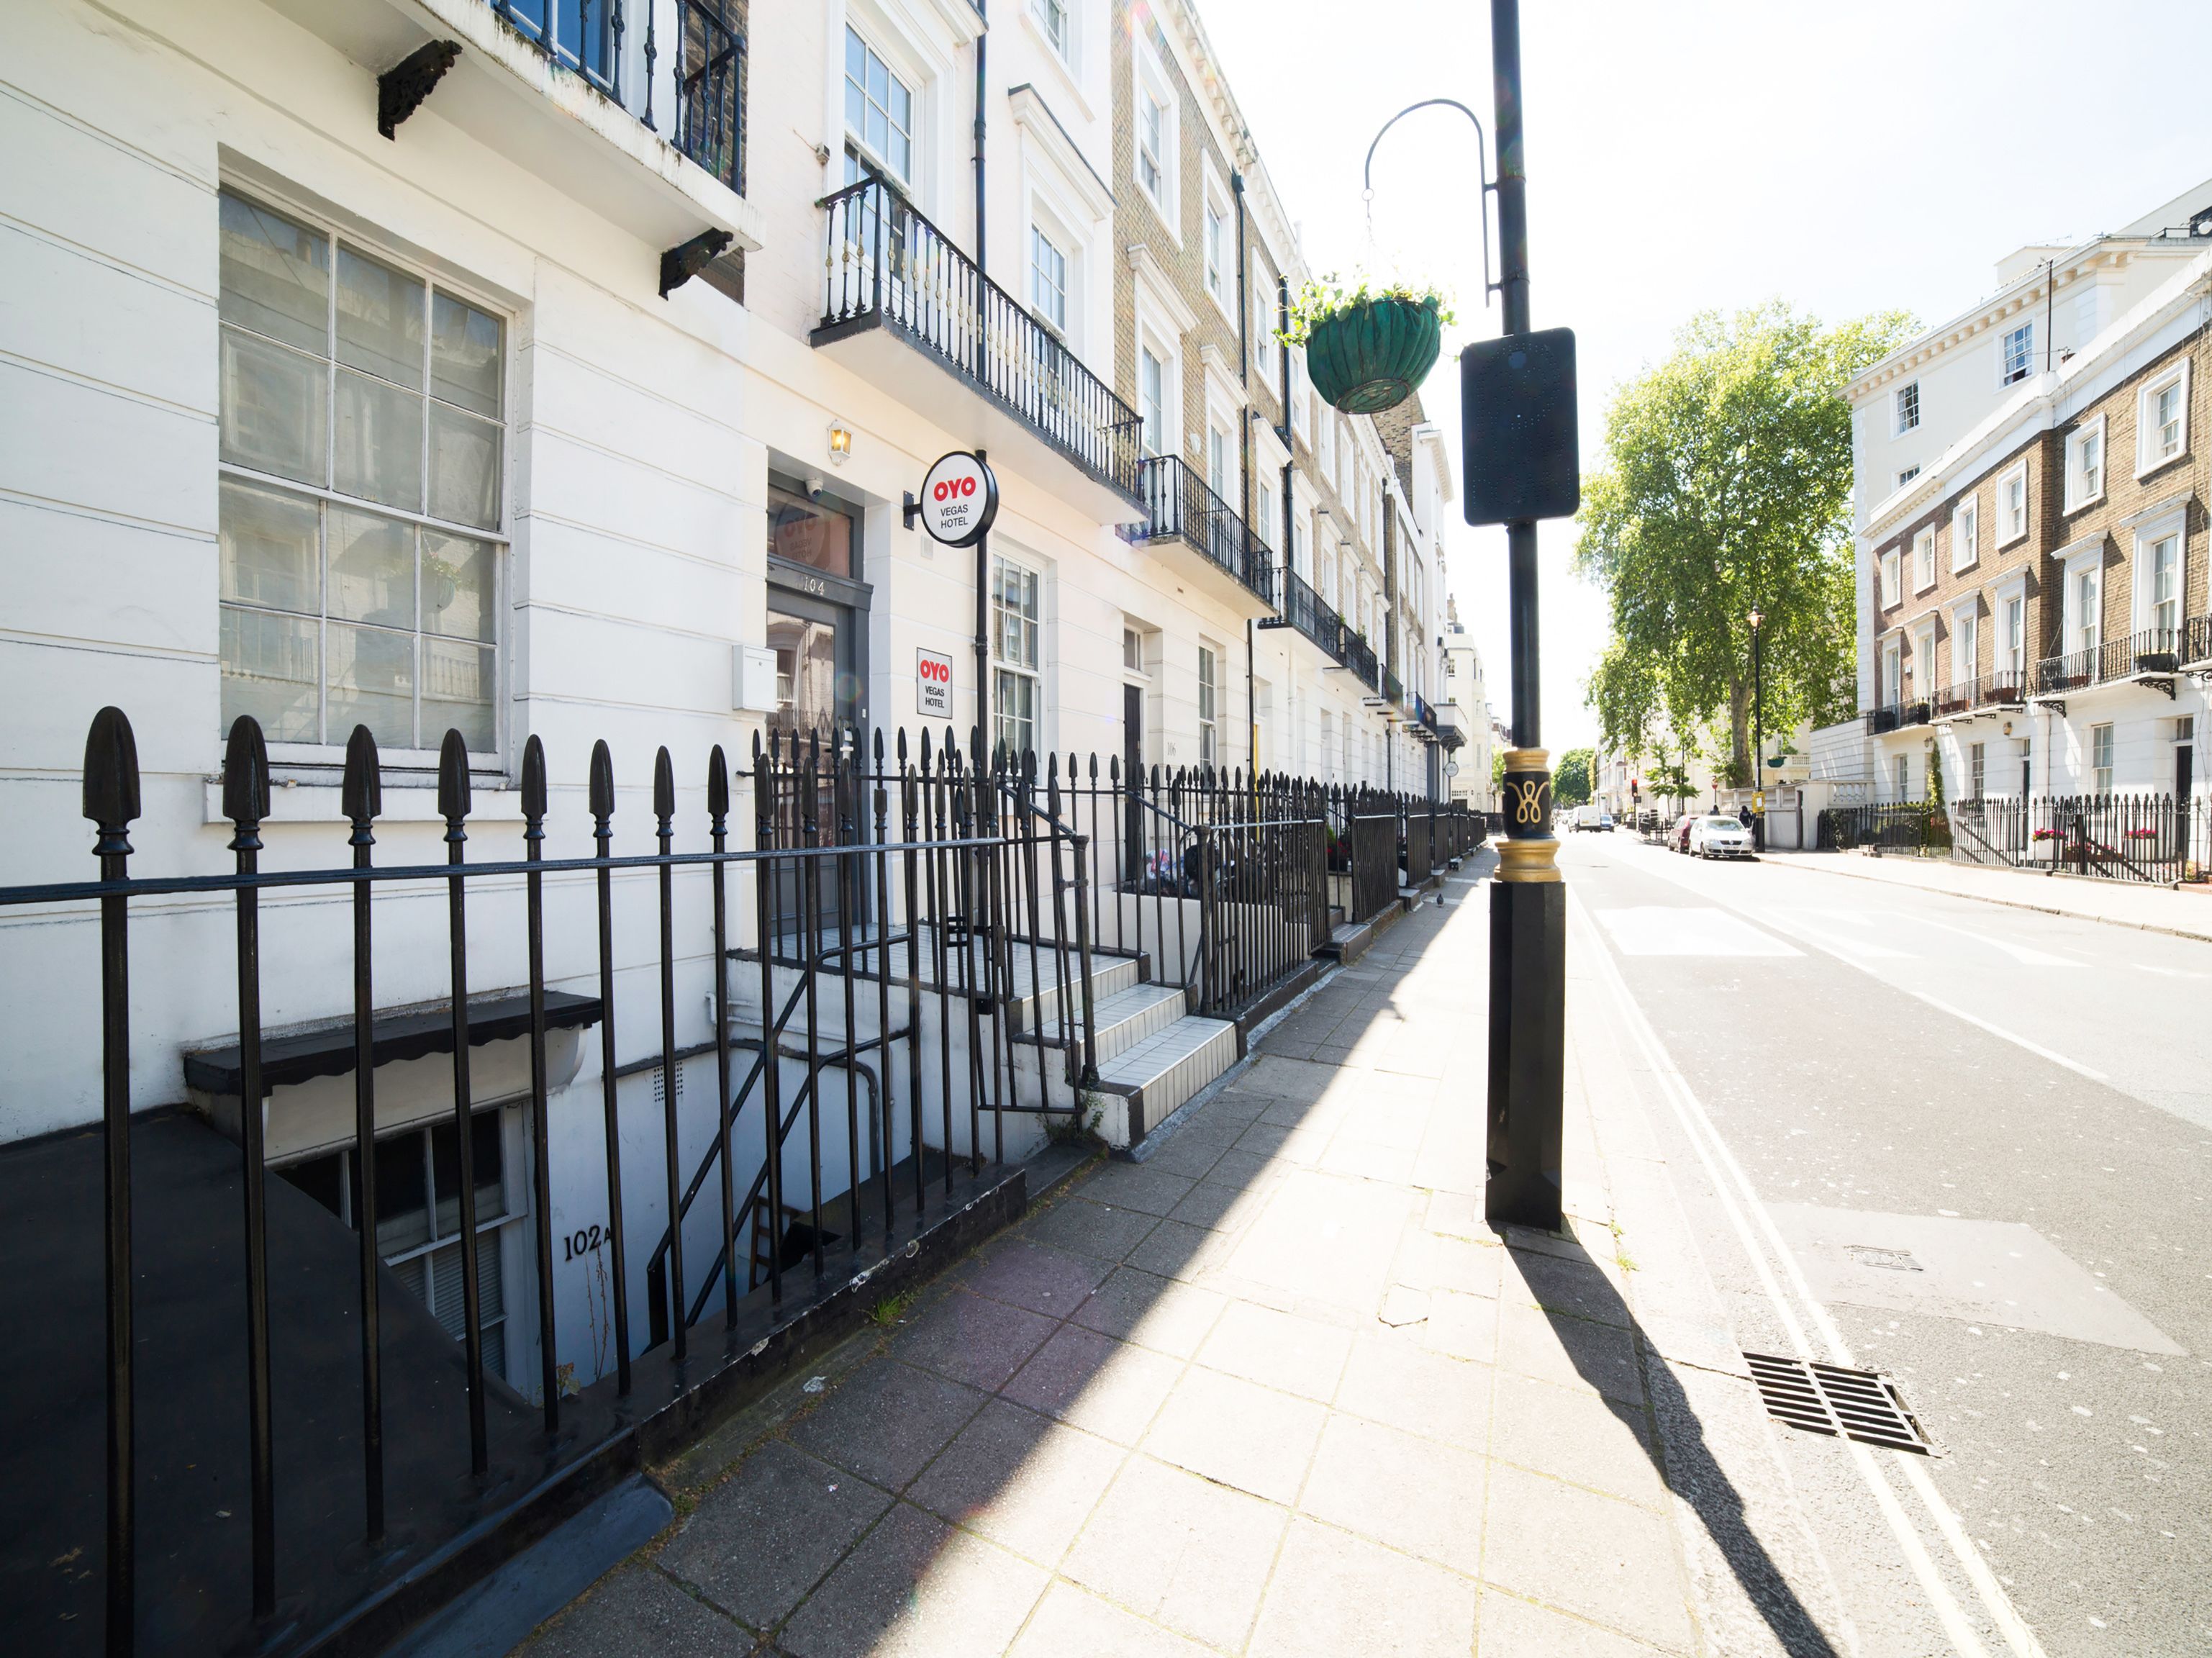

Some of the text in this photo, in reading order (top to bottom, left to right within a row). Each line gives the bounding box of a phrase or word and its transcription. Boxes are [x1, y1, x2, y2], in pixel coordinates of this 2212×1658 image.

[934, 476, 976, 502] OYO
[940, 504, 969, 517] VEGAS
[940, 517, 969, 529] HOTEL
[804, 576, 825, 595] 104
[920, 659, 949, 683] OYO
[925, 685, 945, 697] VEGAS
[925, 697, 945, 709] HOTEL
[1167, 742, 1177, 757] 106
